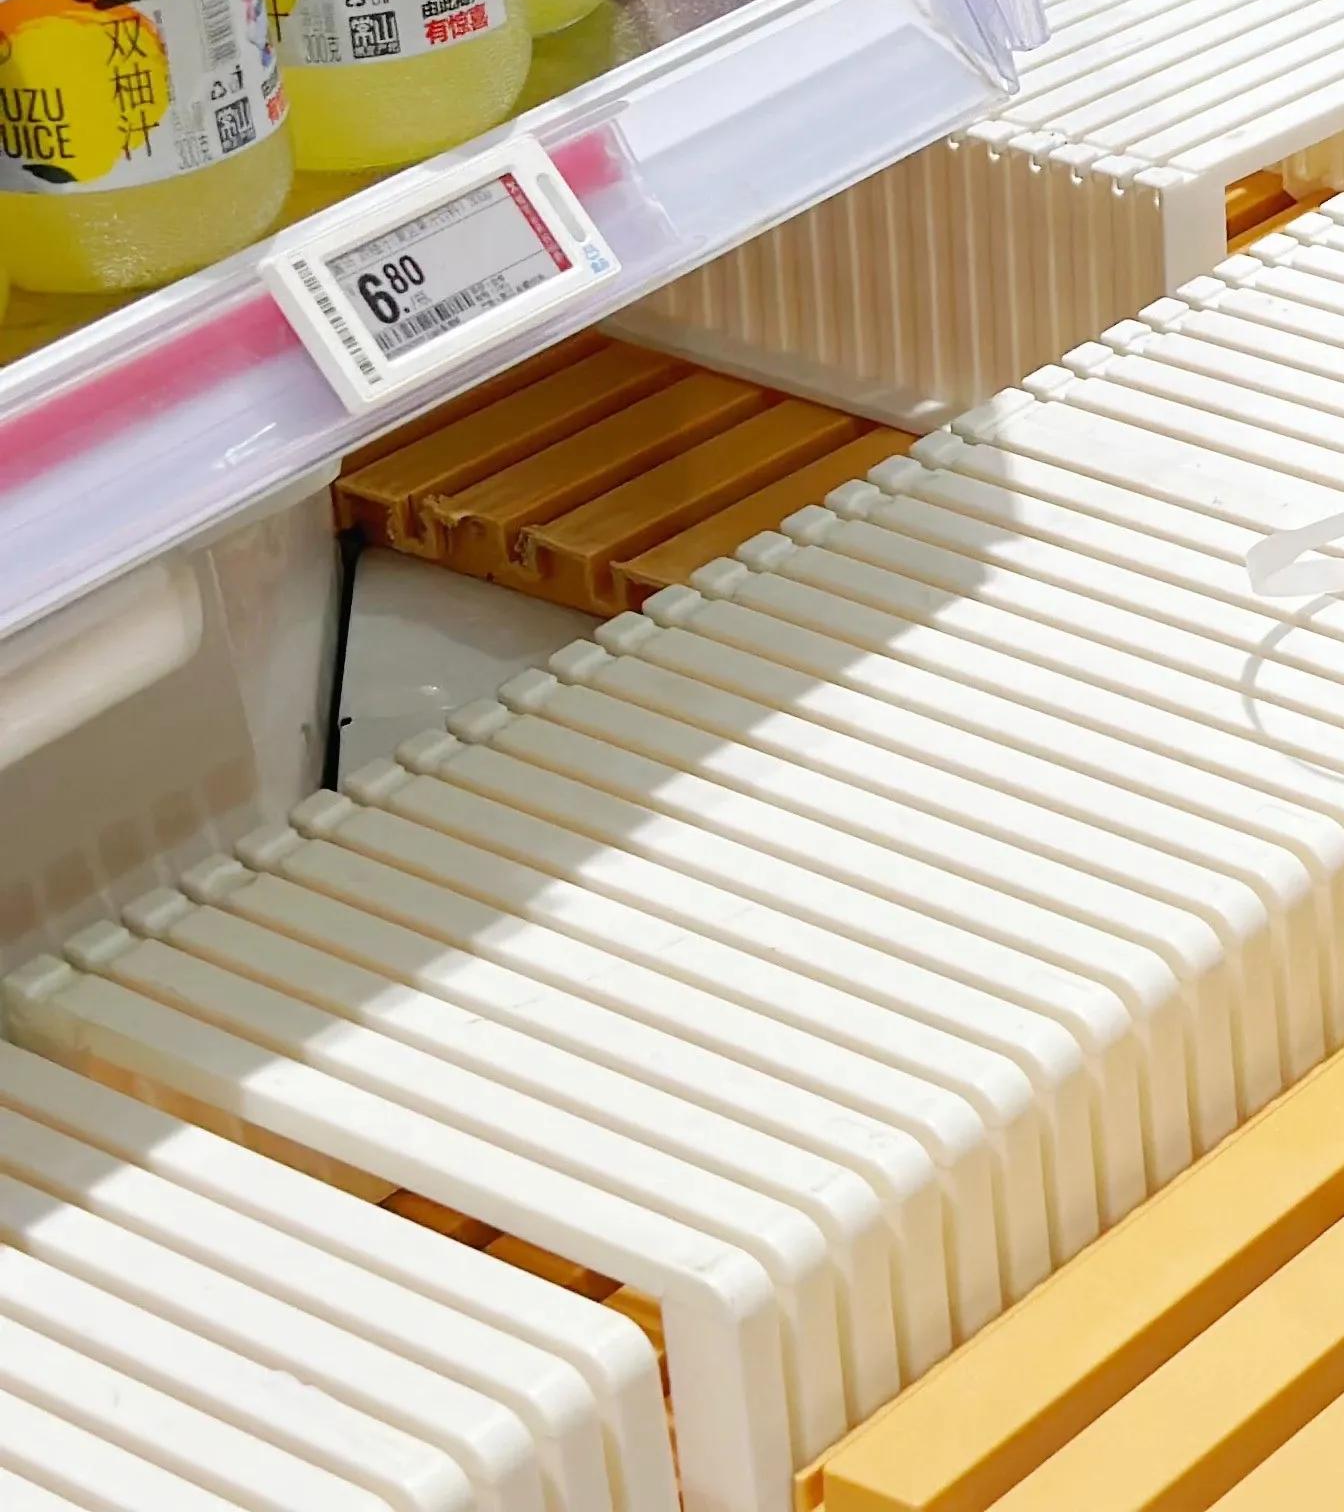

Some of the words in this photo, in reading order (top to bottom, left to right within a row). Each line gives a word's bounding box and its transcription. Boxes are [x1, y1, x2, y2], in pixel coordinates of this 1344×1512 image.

[424, 3, 490, 47] 有惊喜
[101, 15, 160, 161] 双柚汁
[0, 123, 77, 160] UICE
